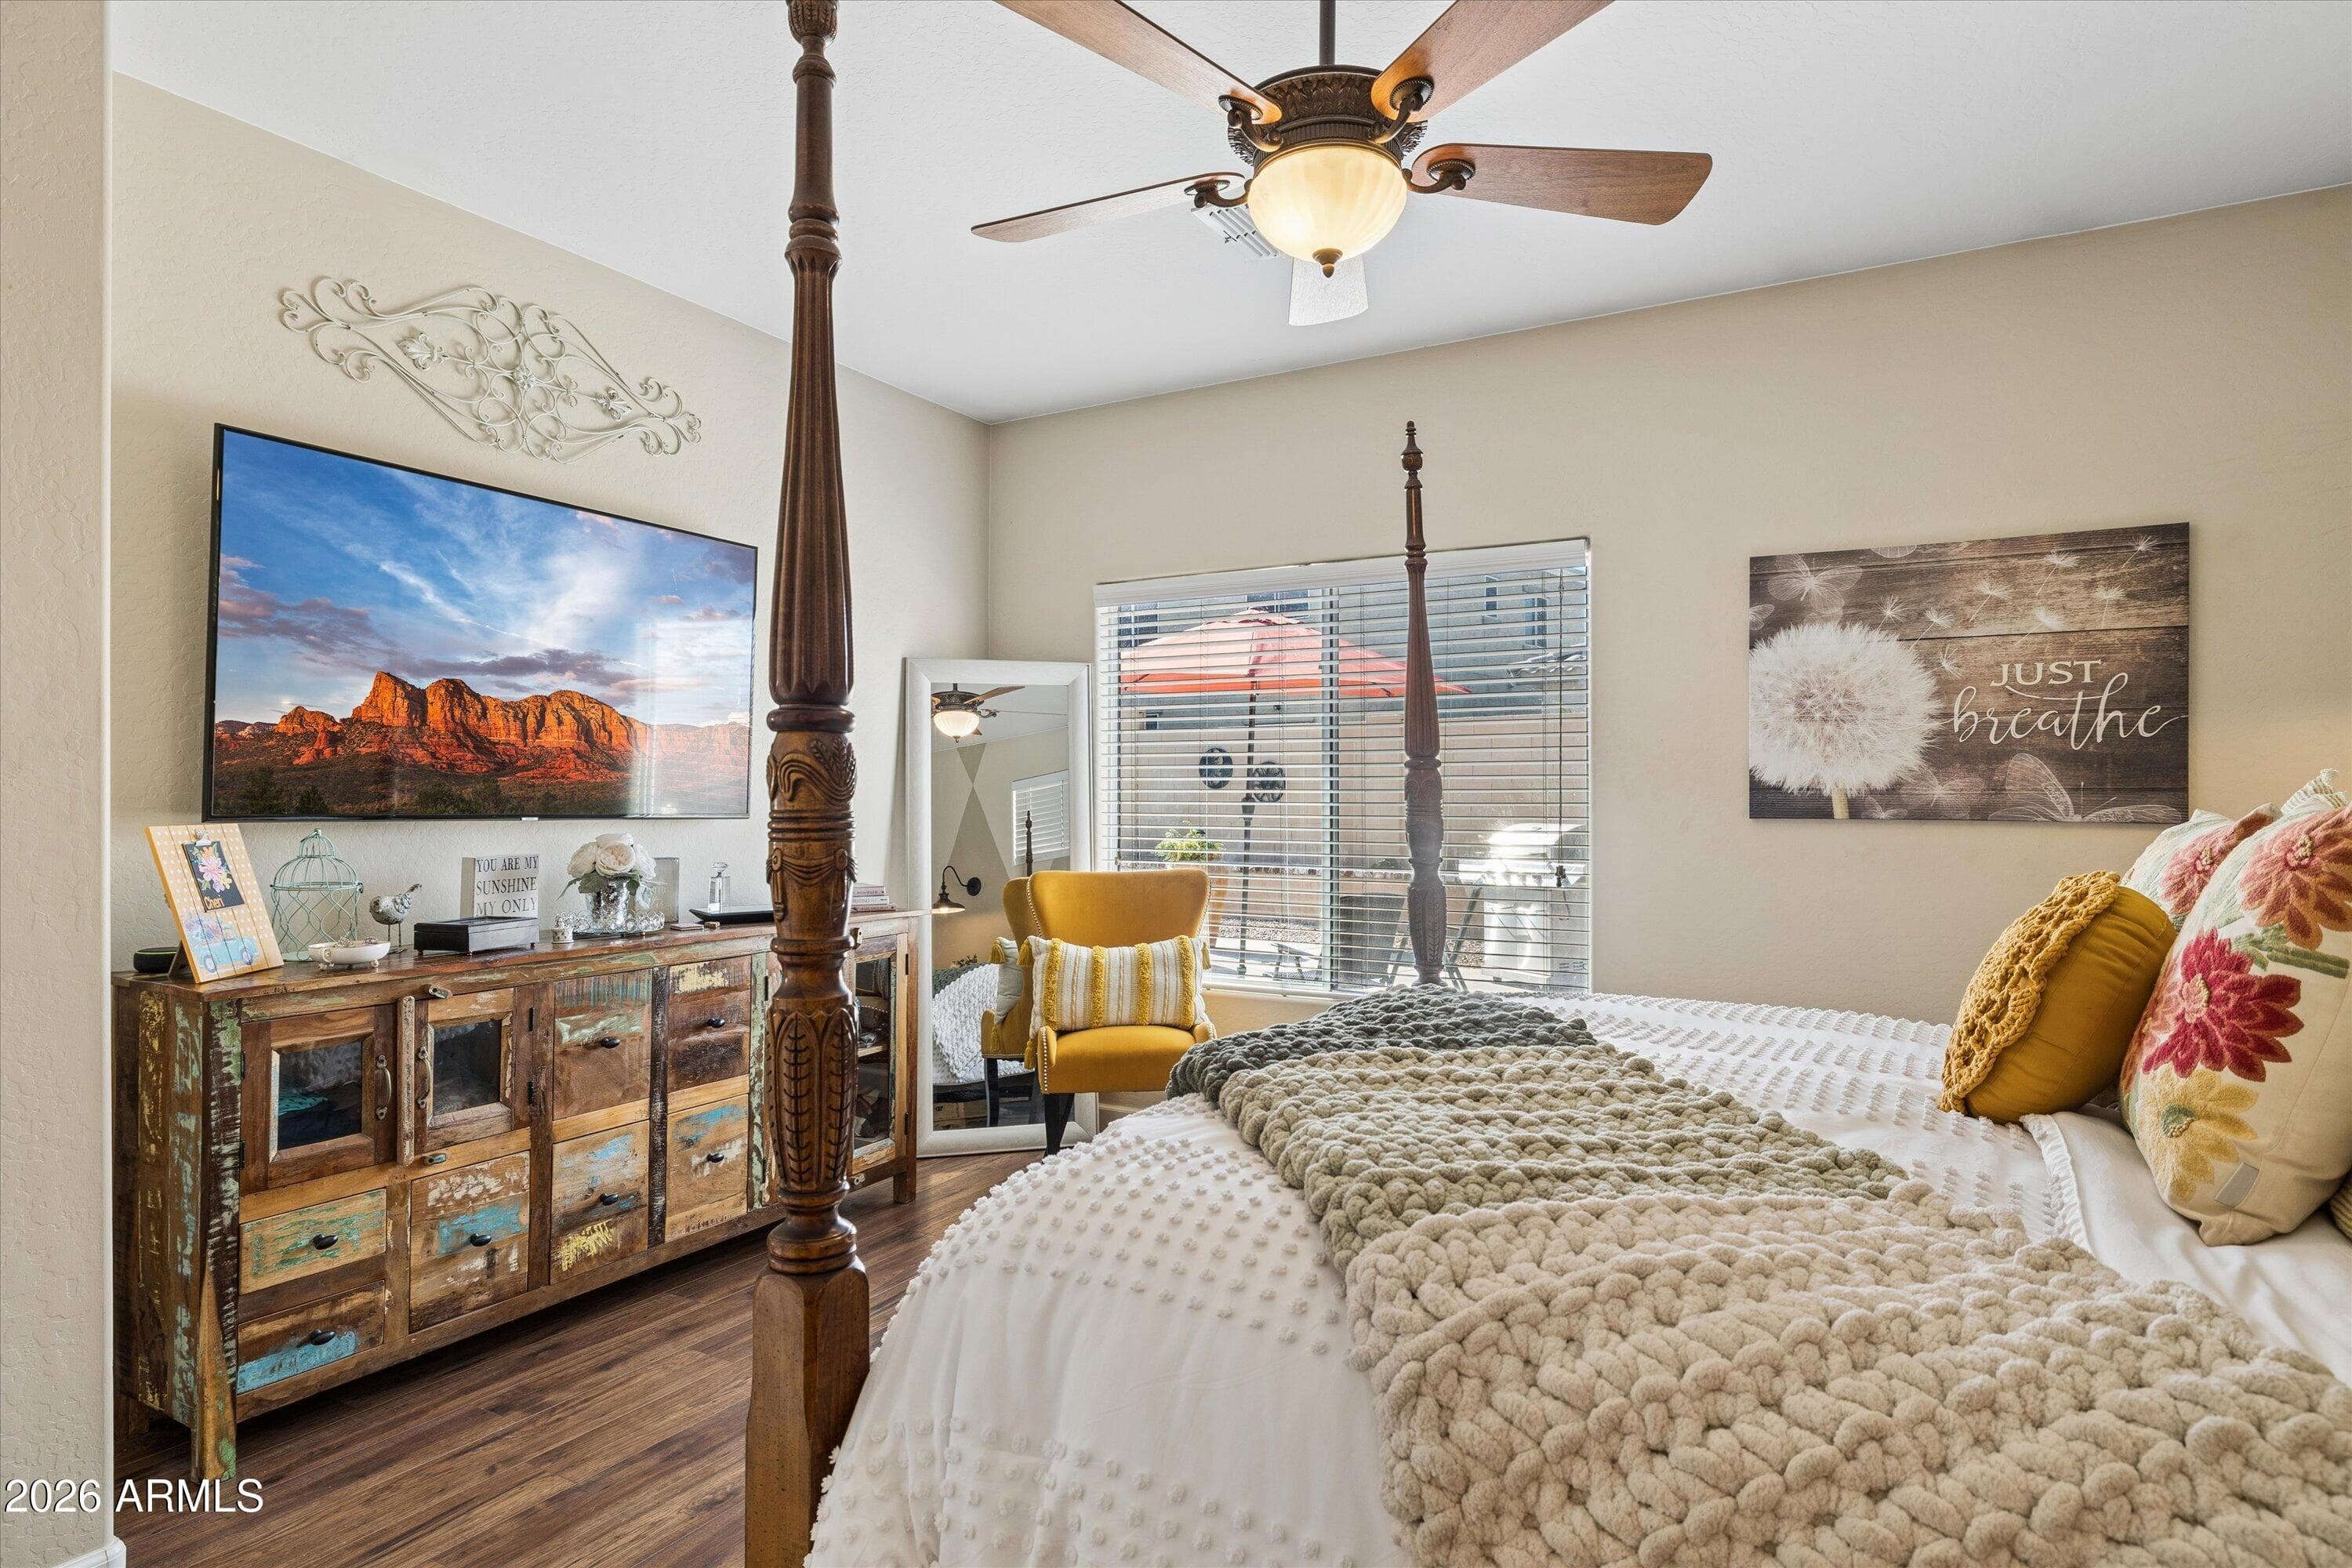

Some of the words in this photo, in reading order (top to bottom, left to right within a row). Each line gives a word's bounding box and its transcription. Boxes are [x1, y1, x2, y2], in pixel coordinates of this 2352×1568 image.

[1990, 659, 2102, 687] JUST
[1952, 672, 2188, 750] breathe
[476, 858, 497, 873] YOU
[501, 856, 521, 871] ARE
[524, 855, 539, 869] MY
[476, 877, 537, 895] SUNSHINE
[476, 901, 495, 916] MY
[502, 897, 537, 914] ONLY
